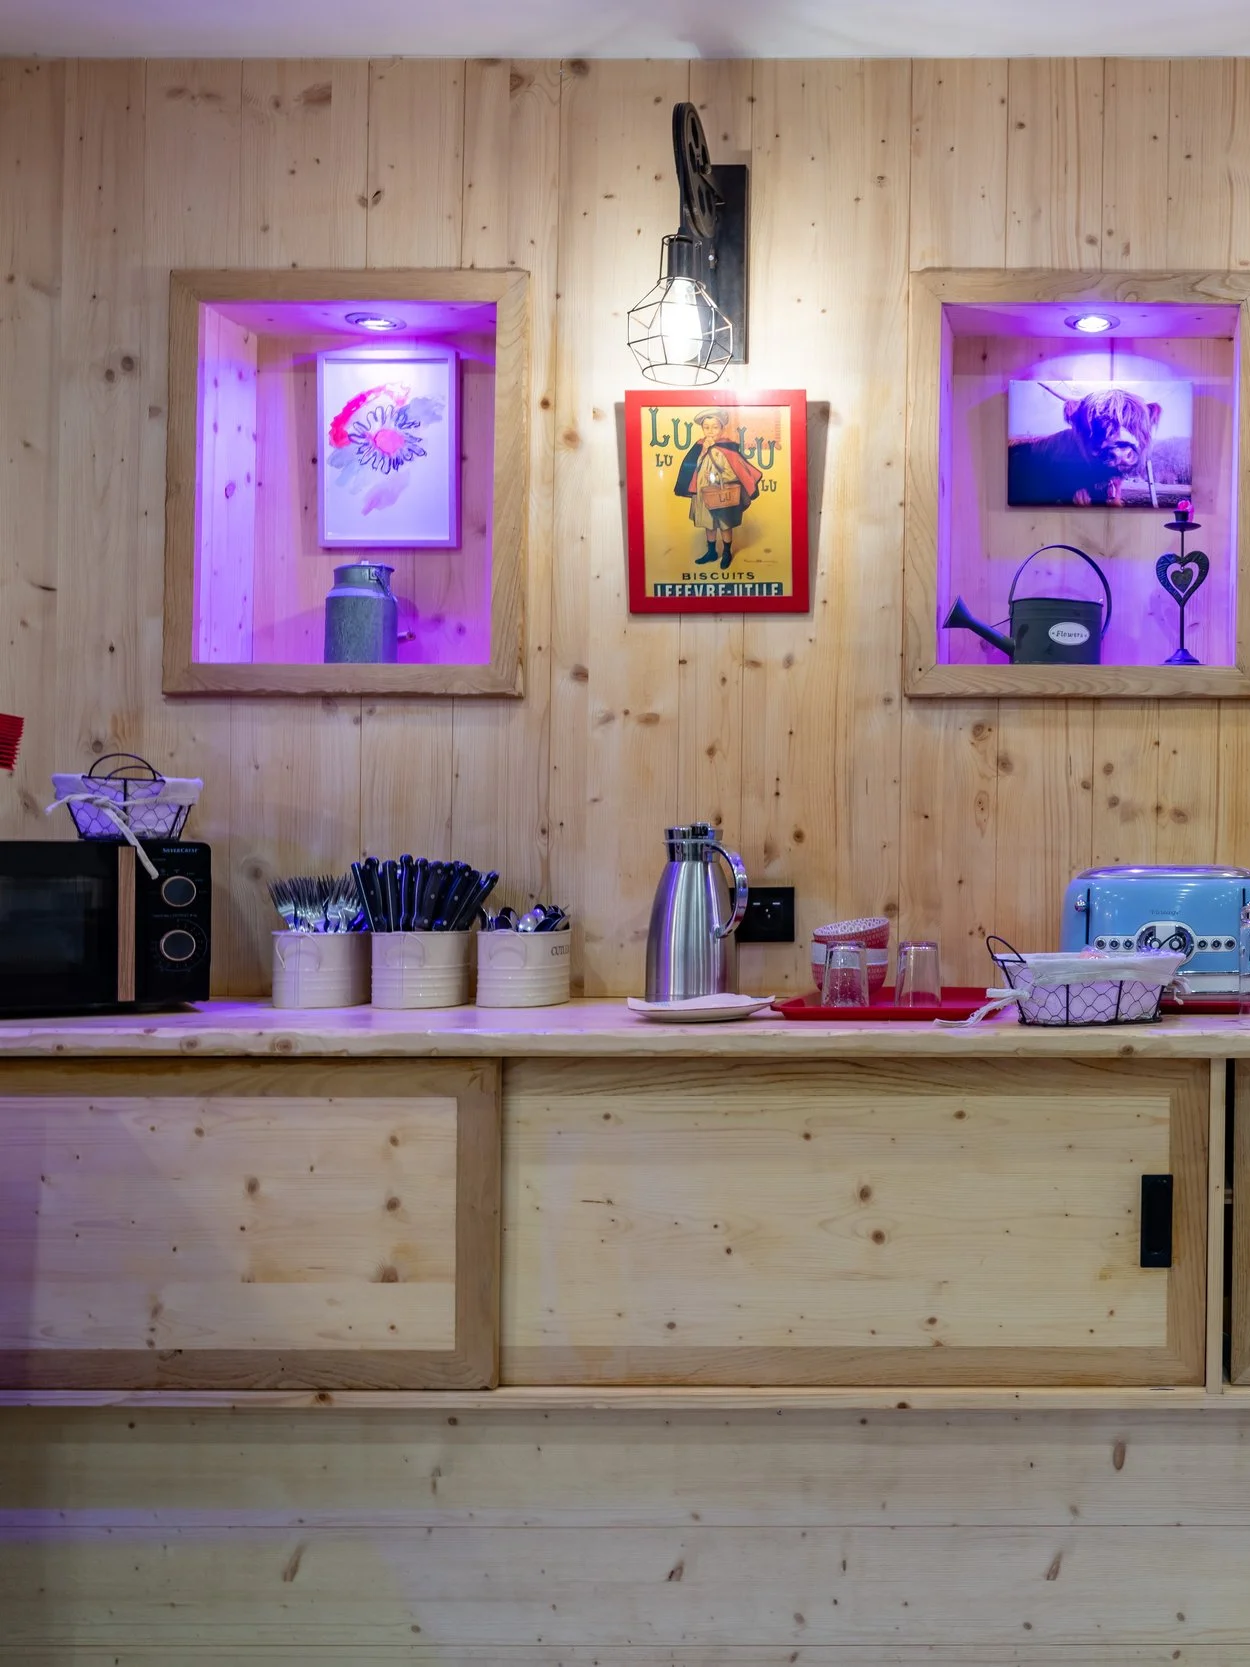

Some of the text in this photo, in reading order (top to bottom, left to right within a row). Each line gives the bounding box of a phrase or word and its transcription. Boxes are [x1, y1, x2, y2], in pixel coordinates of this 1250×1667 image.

[649, 407, 694, 450] LU
[737, 427, 776, 470] LU
[656, 453, 673, 467] LU
[761, 479, 778, 492] LU
[682, 572, 755, 580] BISCUITS
[1056, 630, 1083, 638] Flowers
